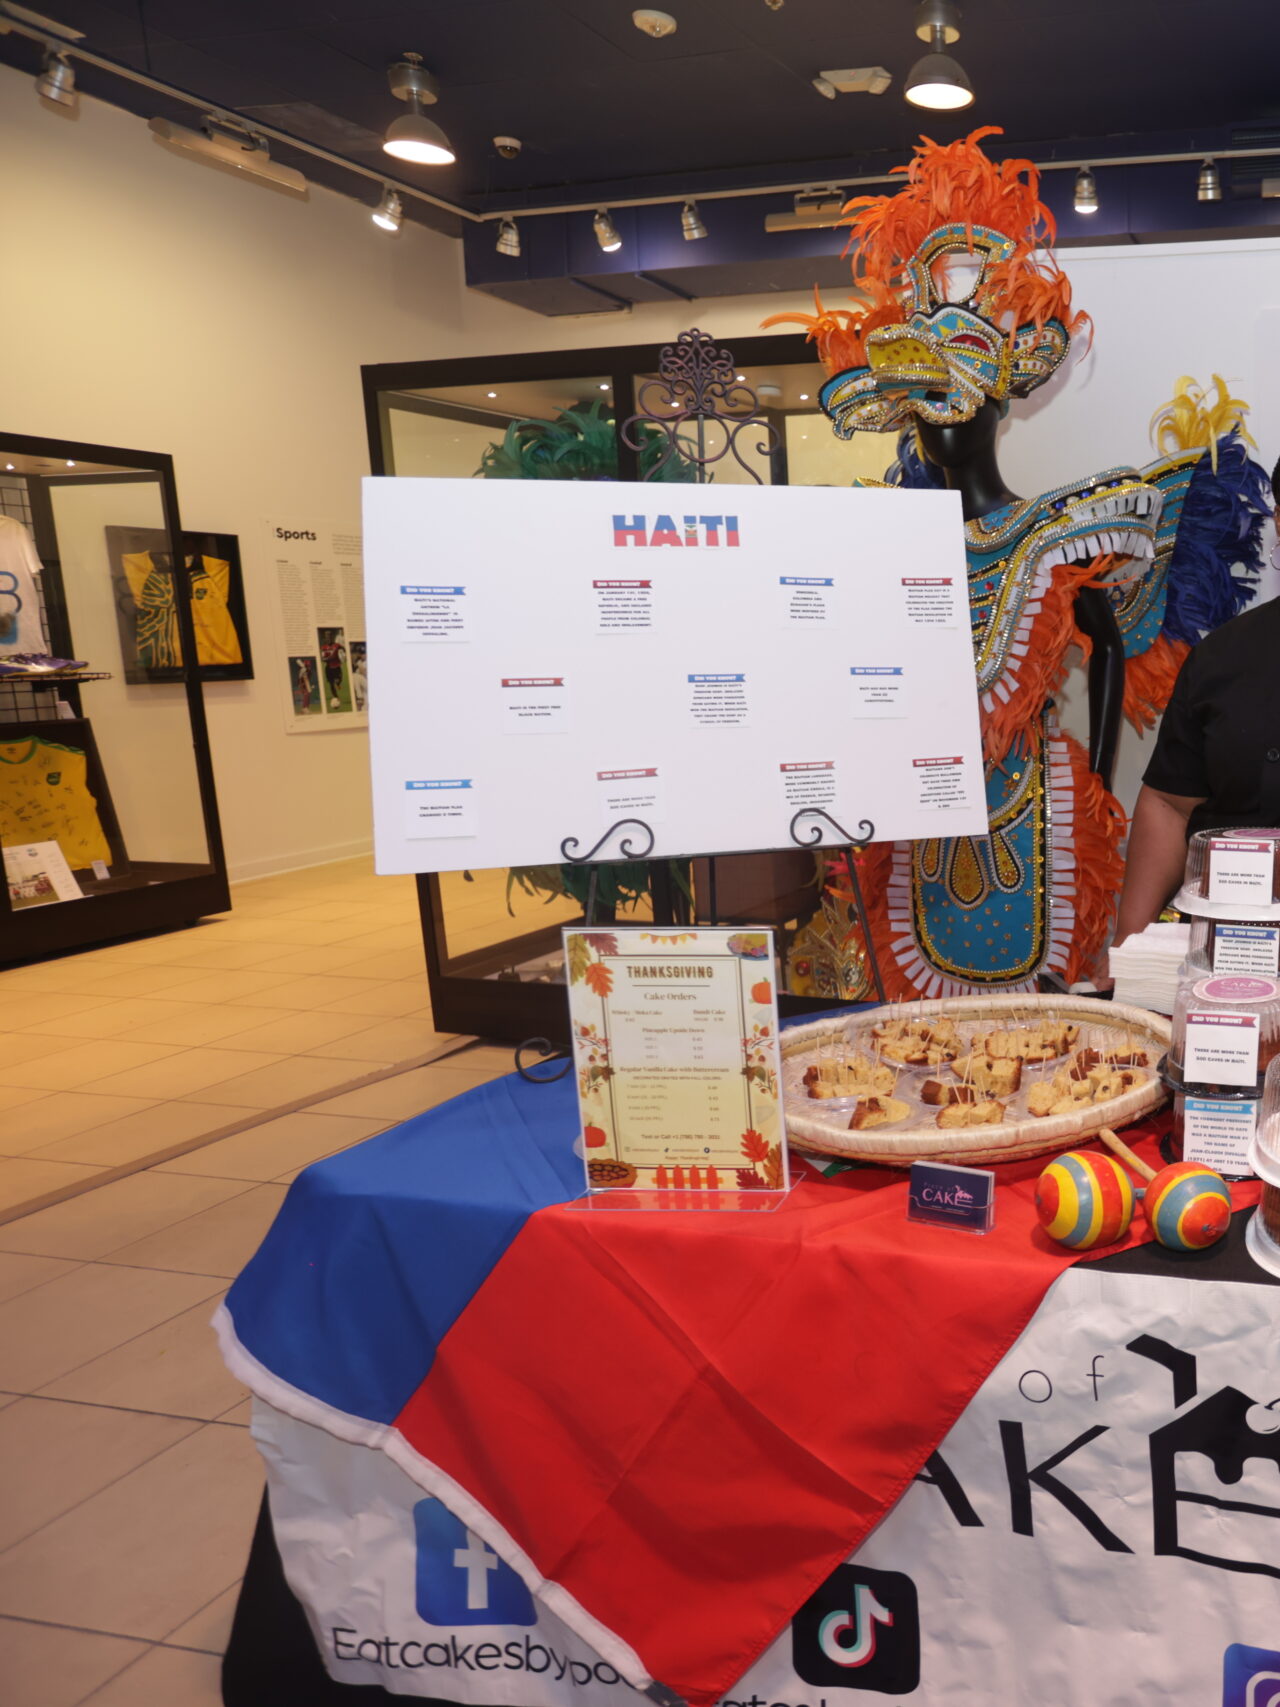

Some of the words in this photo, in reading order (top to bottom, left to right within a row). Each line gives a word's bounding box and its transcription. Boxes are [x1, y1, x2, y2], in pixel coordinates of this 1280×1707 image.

[276, 527, 317, 542] Sports
[612, 515, 740, 547] HAITI
[627, 965, 713, 978] THANKSGIVING
[1018, 1354, 1106, 1404] of
